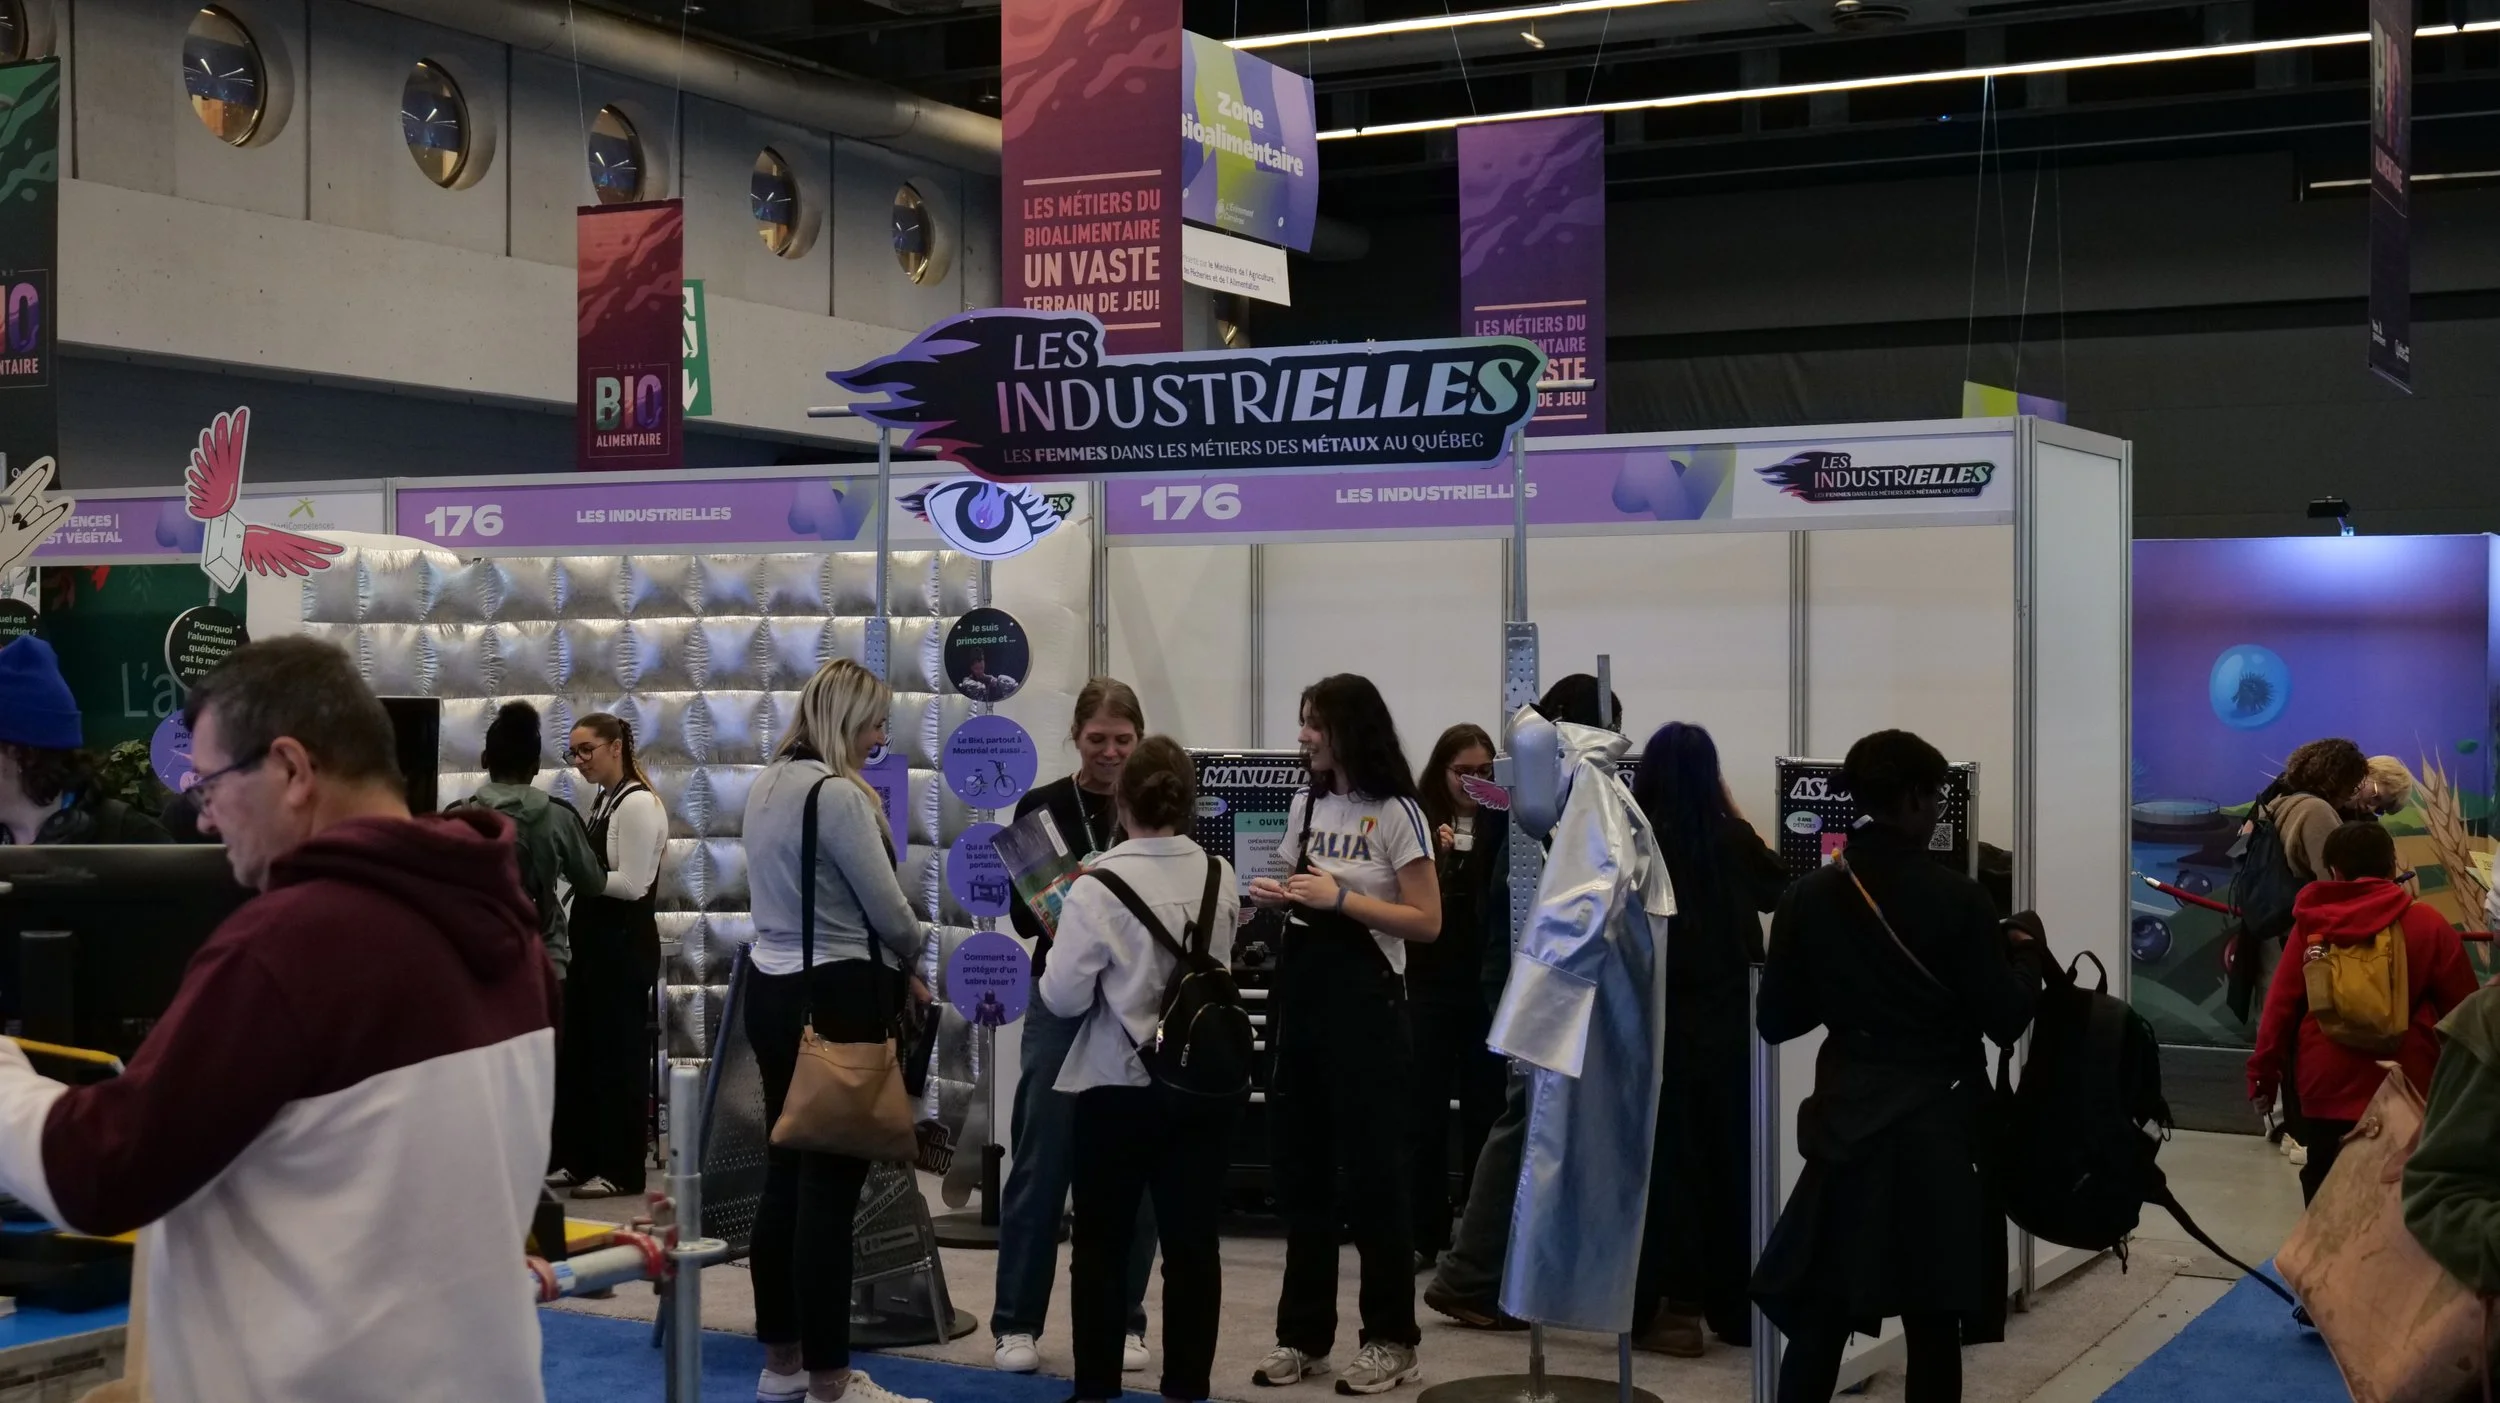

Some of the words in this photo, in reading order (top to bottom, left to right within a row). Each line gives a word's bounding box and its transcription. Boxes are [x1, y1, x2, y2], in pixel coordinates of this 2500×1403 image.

[1217, 91, 1264, 129] Zone
[1024, 198, 1053, 219] LES
[1059, 190, 1132, 217] MÉTIERS
[1137, 189, 1160, 212] DU
[1024, 219, 1160, 247] BIOALIMENTAIRE
[1024, 252, 1062, 288] UN
[1069, 246, 1160, 285] VASTE
[1024, 293, 1094, 313] TERRAIN
[1099, 291, 1119, 313] DE
[1123, 290, 1160, 312] JEU!
[1475, 320, 1499, 336] LES
[1503, 314, 1562, 335] MÉTIERS
[1567, 314, 1586, 332] DU
[1014, 331, 1090, 370] LES
[1540, 357, 1586, 380] STE
[596, 375, 662, 431] BIO
[997, 358, 1524, 433] INDUSTRIELLES
[1537, 393, 1553, 408] DE
[1556, 391, 1586, 407] JEU!
[596, 433, 662, 448] ALIMENTAIRE
[1004, 449, 1031, 463] LES
[1035, 446, 1108, 462] FEMMES
[1111, 444, 1154, 460] DANS
[1158, 443, 1187, 458] LES
[1191, 439, 1261, 457] MÉTIERS
[1266, 439, 1298, 454] DES
[1302, 434, 1380, 453] MÉTAUX
[1383, 435, 1408, 450] AU
[1412, 430, 1484, 452] QUÉBEC
[1821, 455, 1849, 469] LES
[1814, 465, 1989, 489] INDUSTRIELLES
[1336, 488, 1373, 503] LES
[1377, 483, 1538, 502] INDUSTRIELLS
[1141, 484, 1242, 521] 176
[425, 504, 504, 537] 176
[576, 510, 605, 523] LES
[609, 507, 732, 522] INDUSTRIELLES
[66, 528, 123, 544] VÉGÉTAL
[13, 616, 27, 624] est
[194, 621, 233, 634] Pourquoi
[971, 624, 981, 633] Je
[981, 624, 999, 632] suis
[187, 631, 237, 646] l'aluminium
[956, 637, 997, 647] princesse
[998, 635, 1008, 643] et
[195, 656, 204, 664] le
[1017, 735, 1022, 743] à
[965, 843, 977, 851] Qui
[969, 862, 1002, 870] portative
[964, 953, 1002, 962] Comment
[1006, 954, 1016, 962] se
[963, 964, 998, 974] protéger
[999, 964, 1018, 974] d'un
[965, 977, 987, 985] sabre
[989, 977, 1009, 986] laser
